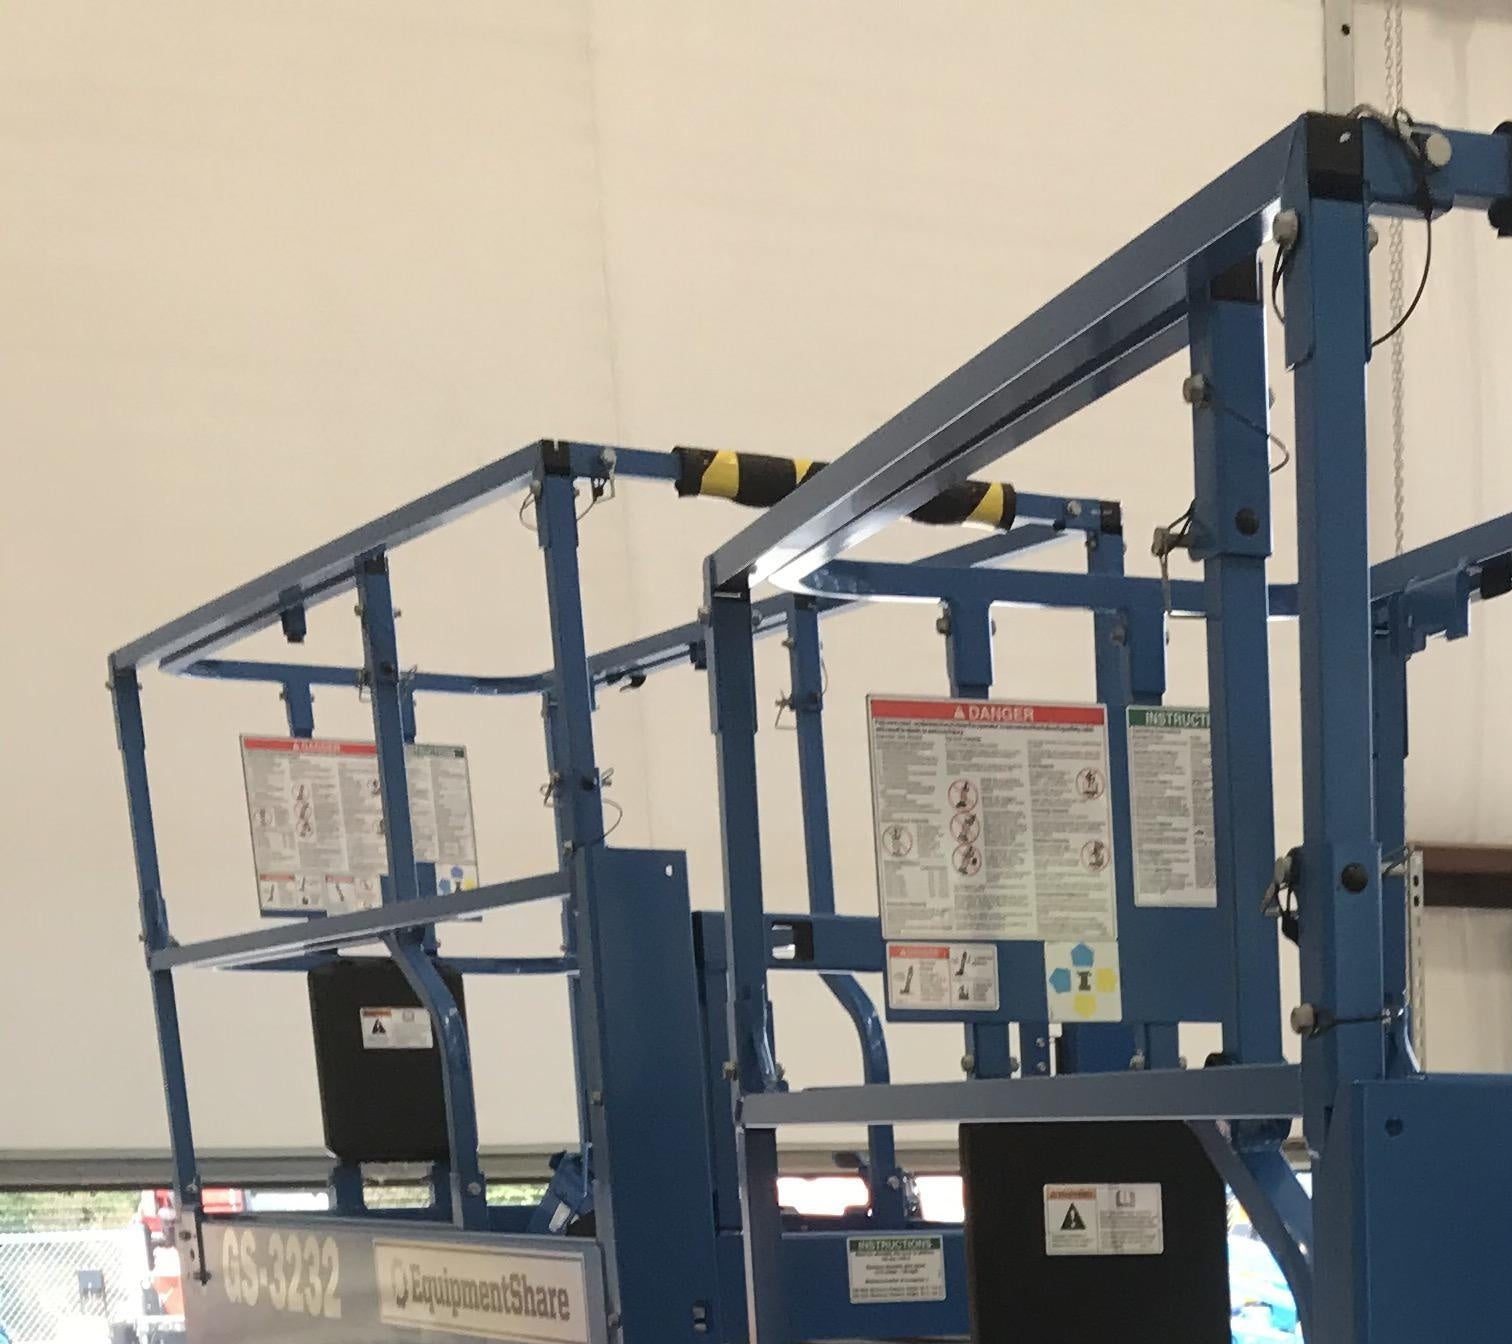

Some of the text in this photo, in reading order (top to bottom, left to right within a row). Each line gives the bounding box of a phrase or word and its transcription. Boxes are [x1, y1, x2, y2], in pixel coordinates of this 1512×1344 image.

[969, 705, 1035, 722] DANGER
[1145, 710, 1211, 728] INSTRUCTI
[222, 1226, 342, 1319] GS-3232
[412, 1263, 570, 1322] EquipmentShare
